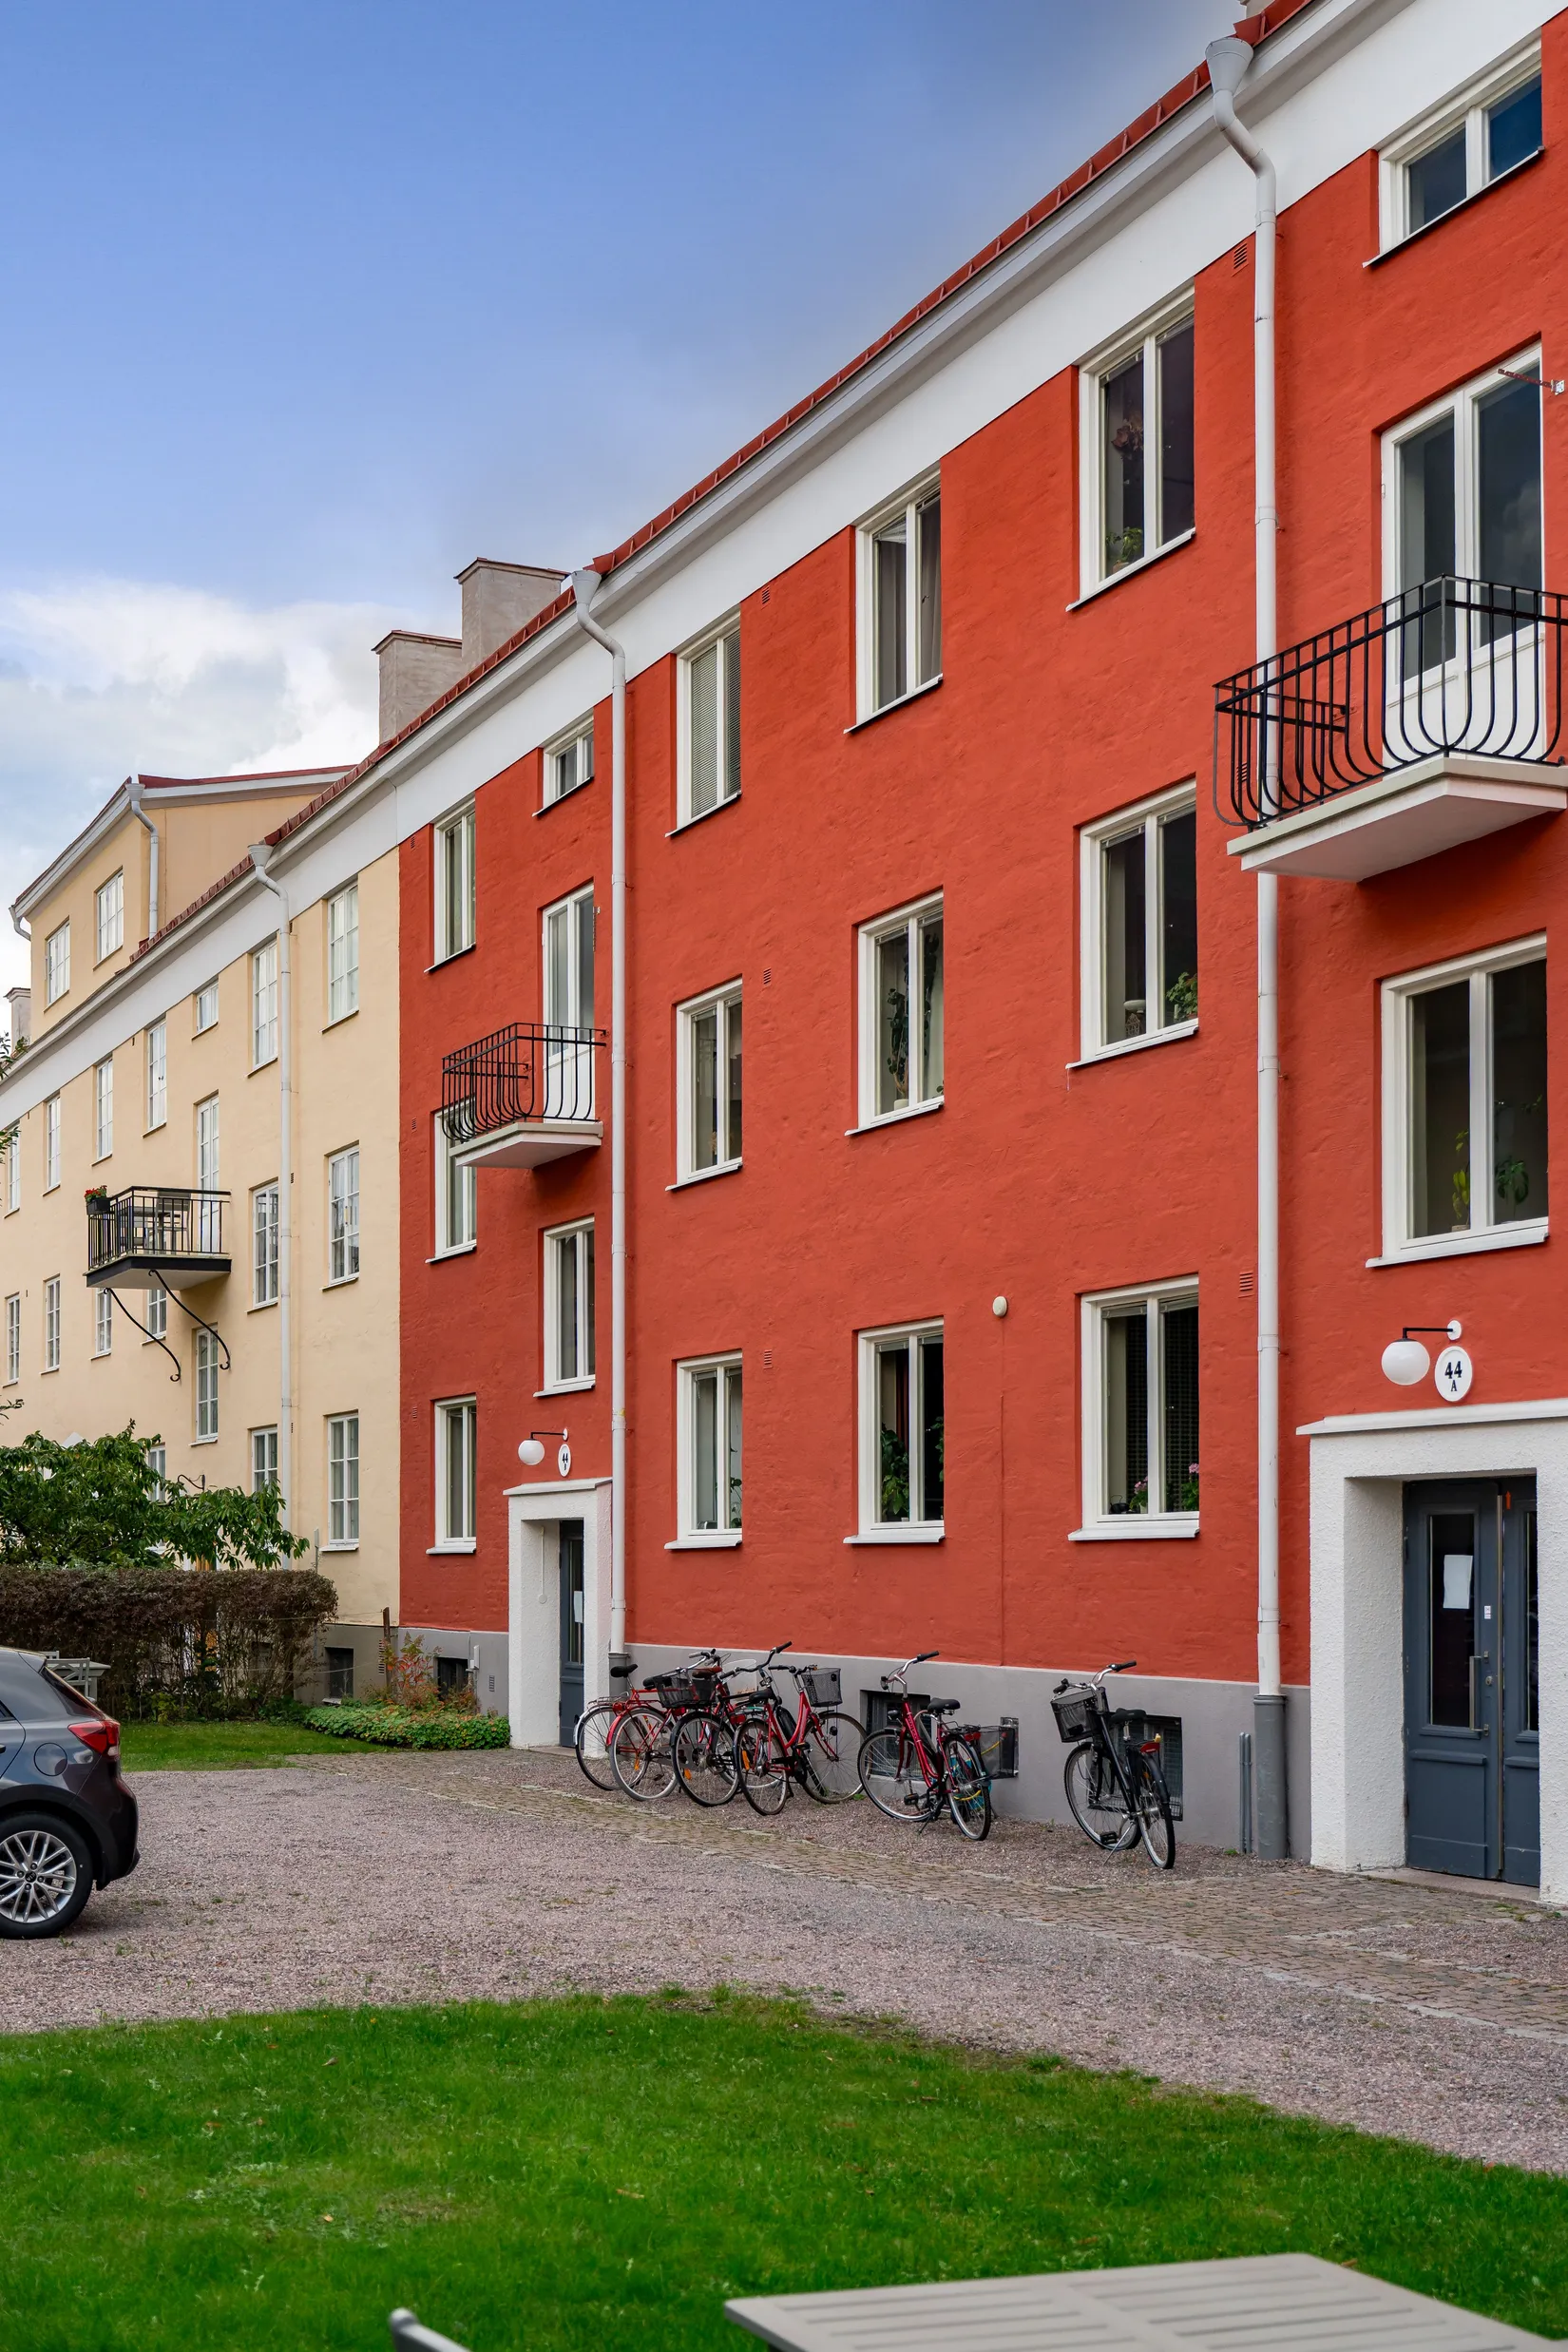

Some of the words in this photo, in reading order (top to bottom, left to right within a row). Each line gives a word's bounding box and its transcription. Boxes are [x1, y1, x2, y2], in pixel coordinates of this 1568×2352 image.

[1444, 1361, 1463, 1379] 44
[1451, 1380, 1458, 1392] A
[562, 1453, 568, 1463] 44
